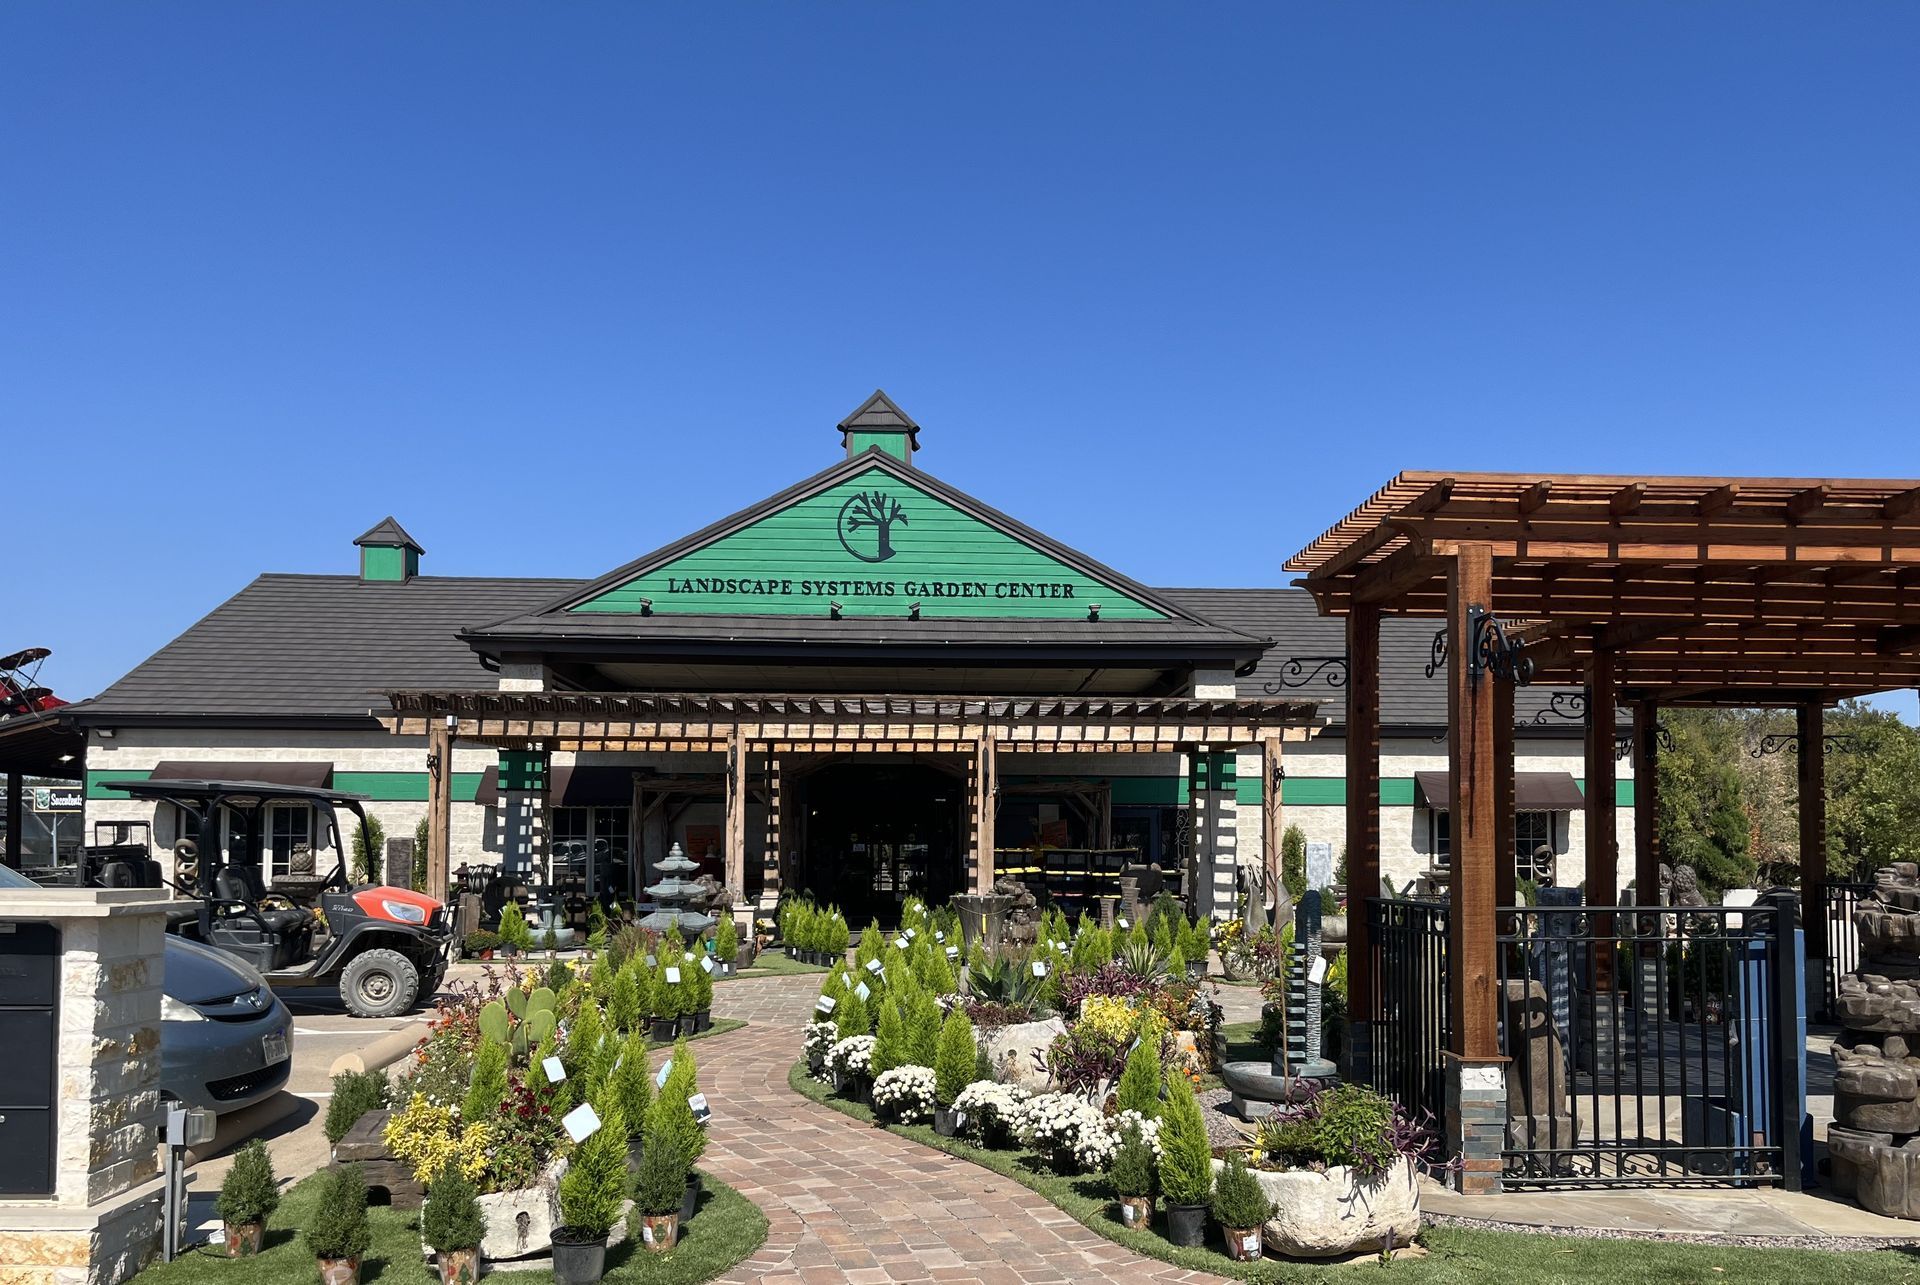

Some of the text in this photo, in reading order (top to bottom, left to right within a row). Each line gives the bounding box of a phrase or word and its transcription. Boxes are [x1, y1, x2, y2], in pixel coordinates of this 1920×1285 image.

[668, 578, 1075, 599] LANDSCAPE SYSTEMS GARDEN CENTER
